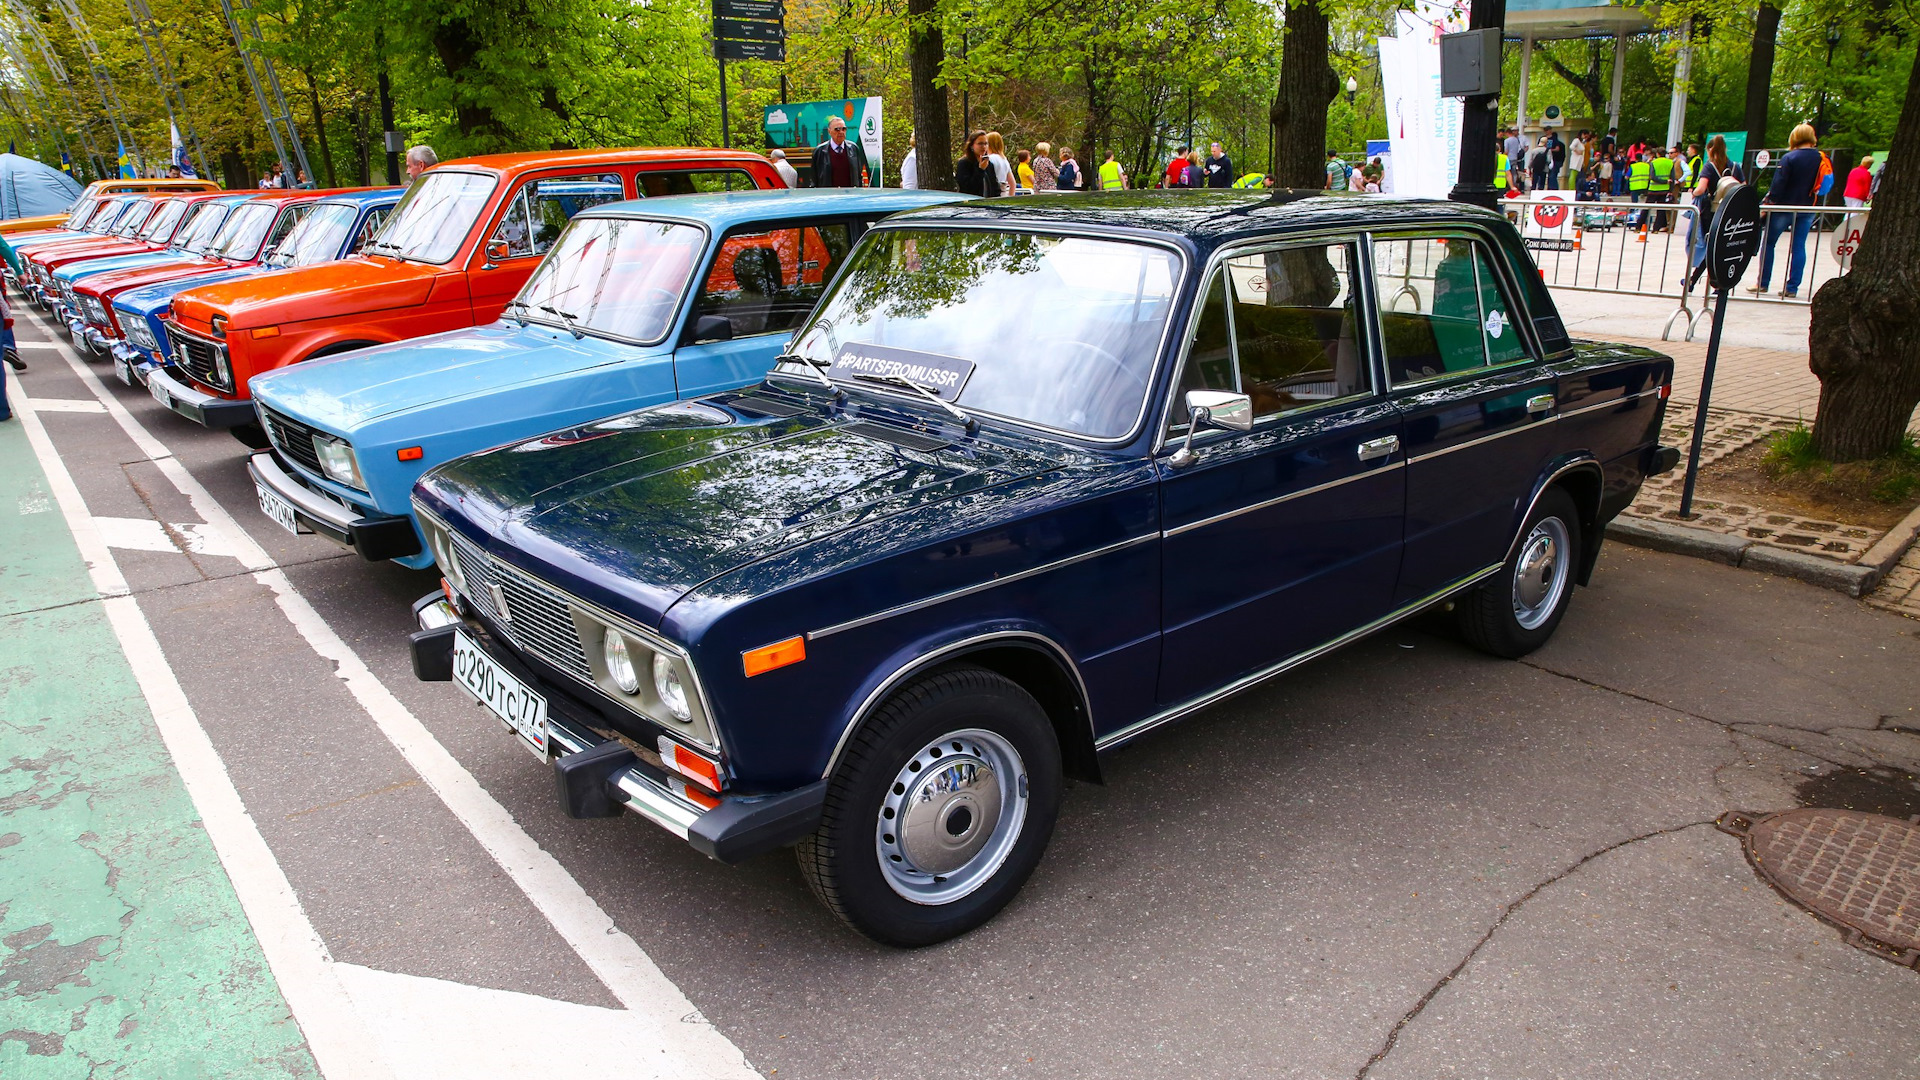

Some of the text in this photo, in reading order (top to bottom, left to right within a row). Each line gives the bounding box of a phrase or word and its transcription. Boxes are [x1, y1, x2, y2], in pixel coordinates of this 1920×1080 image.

[836, 352, 959, 387] #PARTSFROMUSSR
[521, 689, 539, 726] 77
[520, 719, 533, 736] RUS
